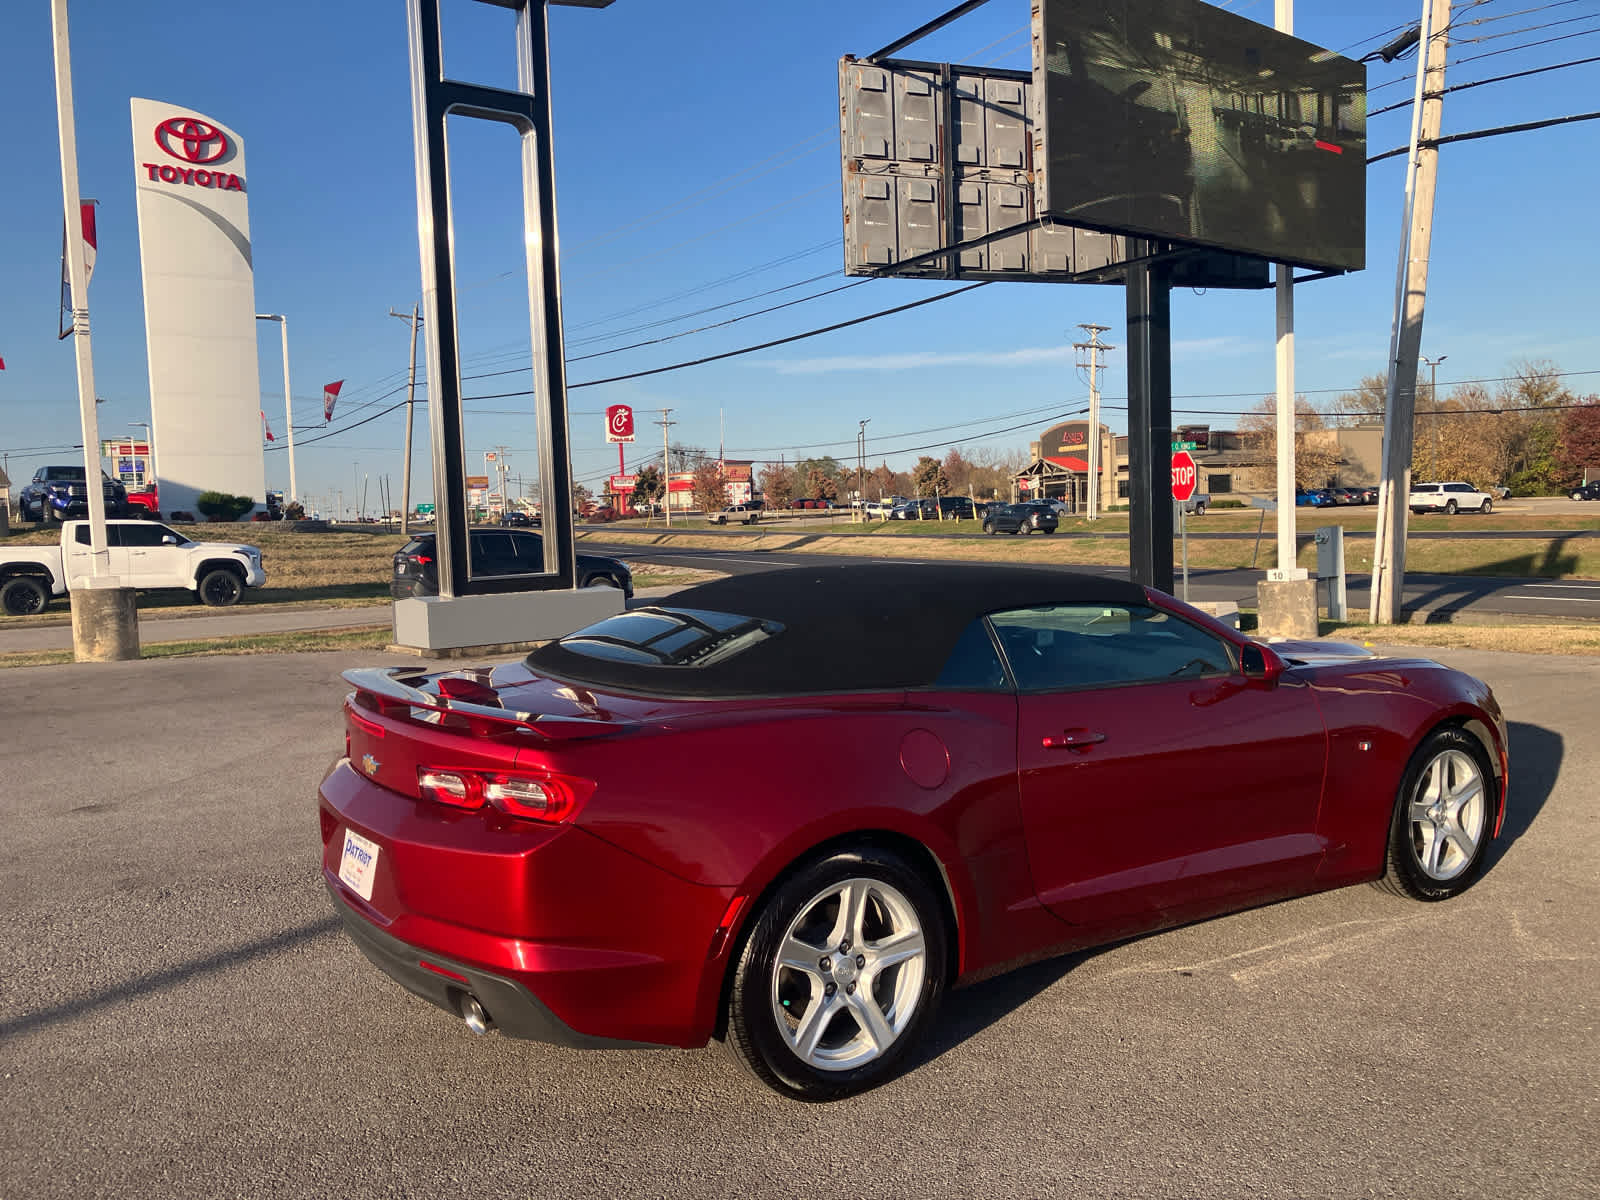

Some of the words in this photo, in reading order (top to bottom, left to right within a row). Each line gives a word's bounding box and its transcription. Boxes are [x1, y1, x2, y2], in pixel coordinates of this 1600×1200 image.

[142, 163, 243, 191] TOYOTA
[1171, 466, 1194, 486] STOP
[1273, 571, 1283, 580] 10
[344, 838, 372, 868] PATRIOT
